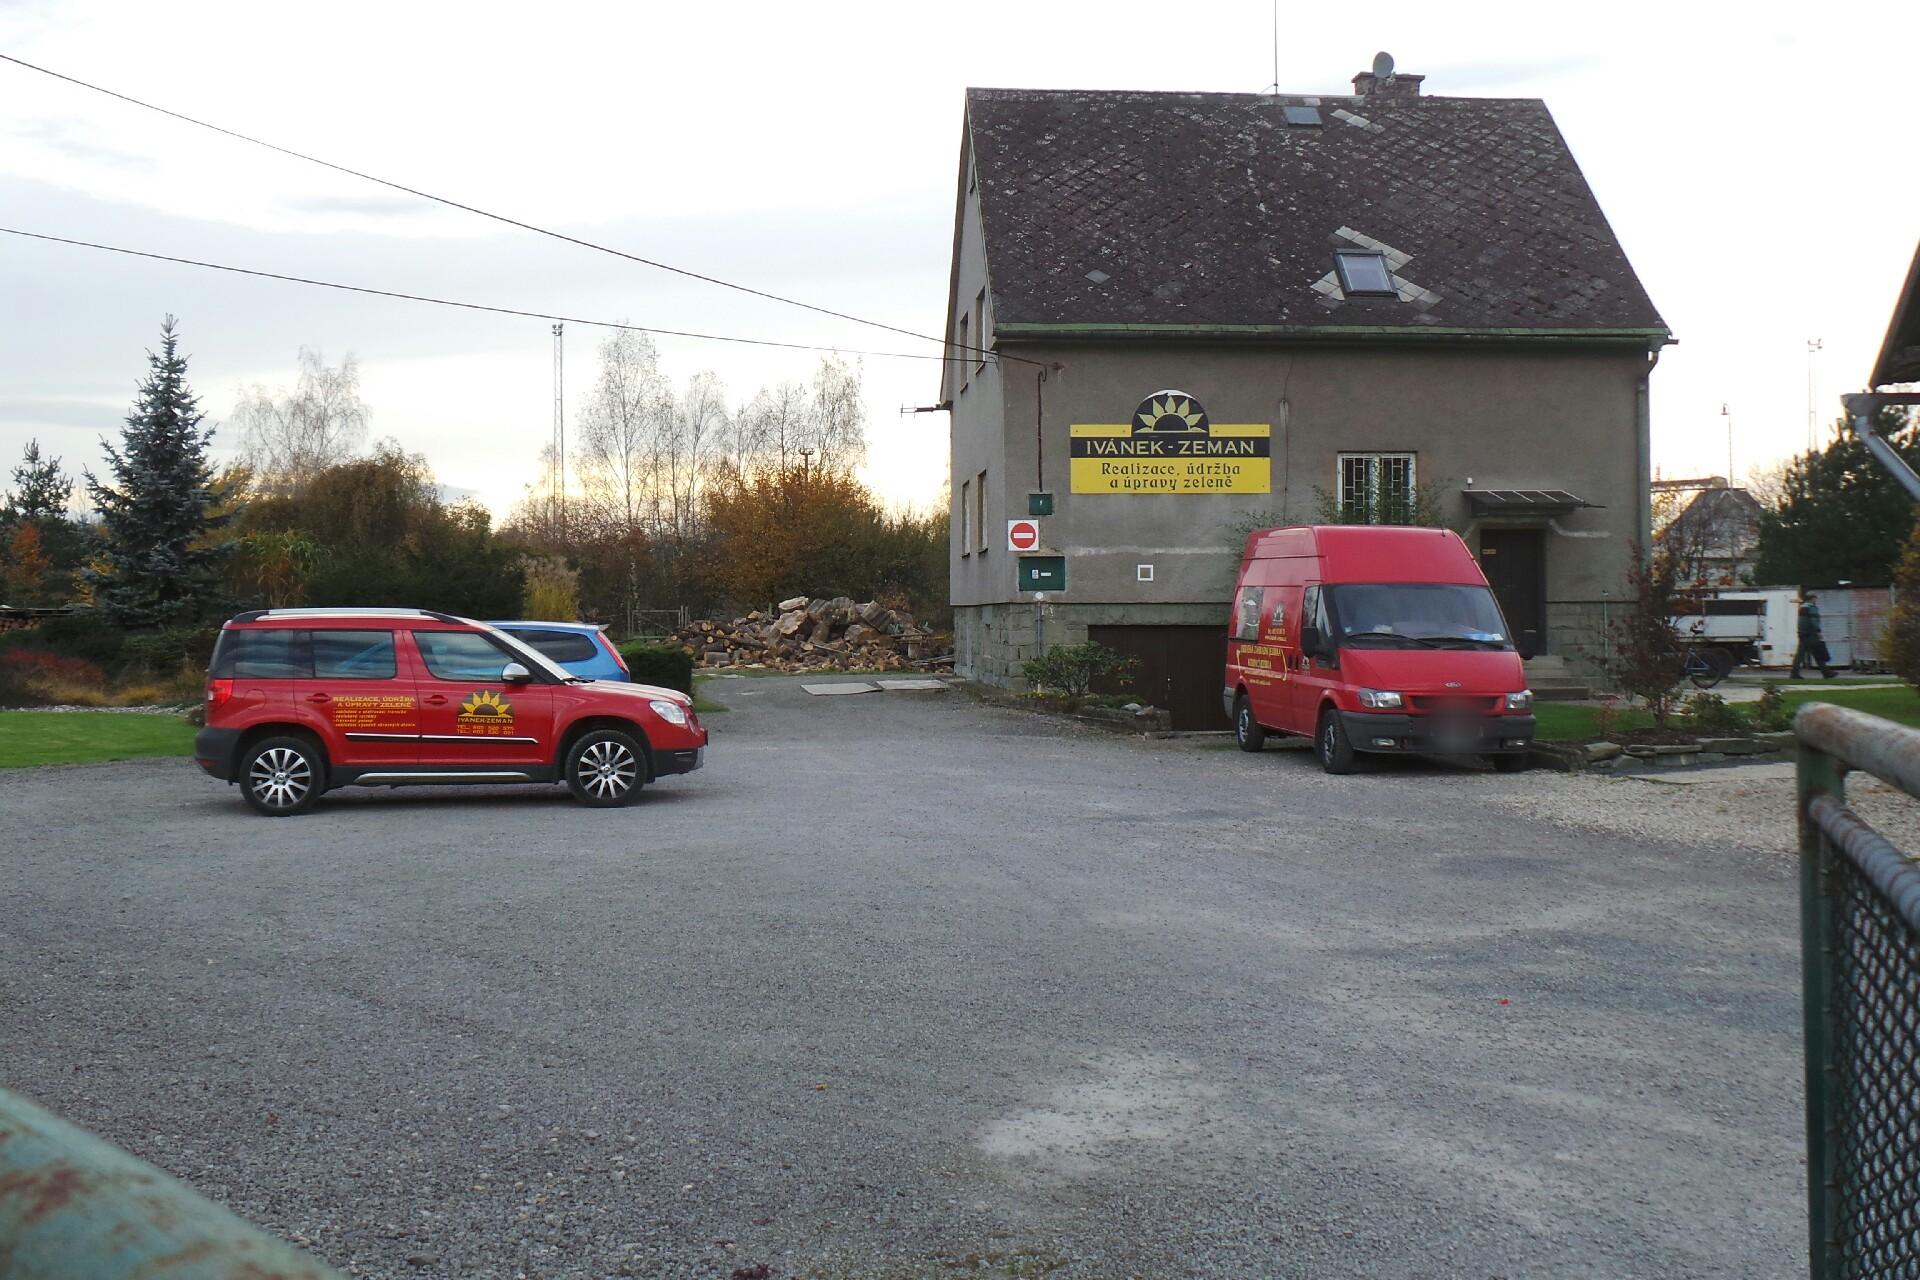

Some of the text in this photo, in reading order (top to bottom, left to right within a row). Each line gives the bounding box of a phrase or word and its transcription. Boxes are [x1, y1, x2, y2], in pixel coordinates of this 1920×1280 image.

[1086, 438, 1164, 455] IVÁNEK
[1178, 440, 1255, 455] ZEMAN
[1101, 462, 1241, 476] Realizace, údržba
[1109, 476, 1233, 490] a úpravy zeleně
